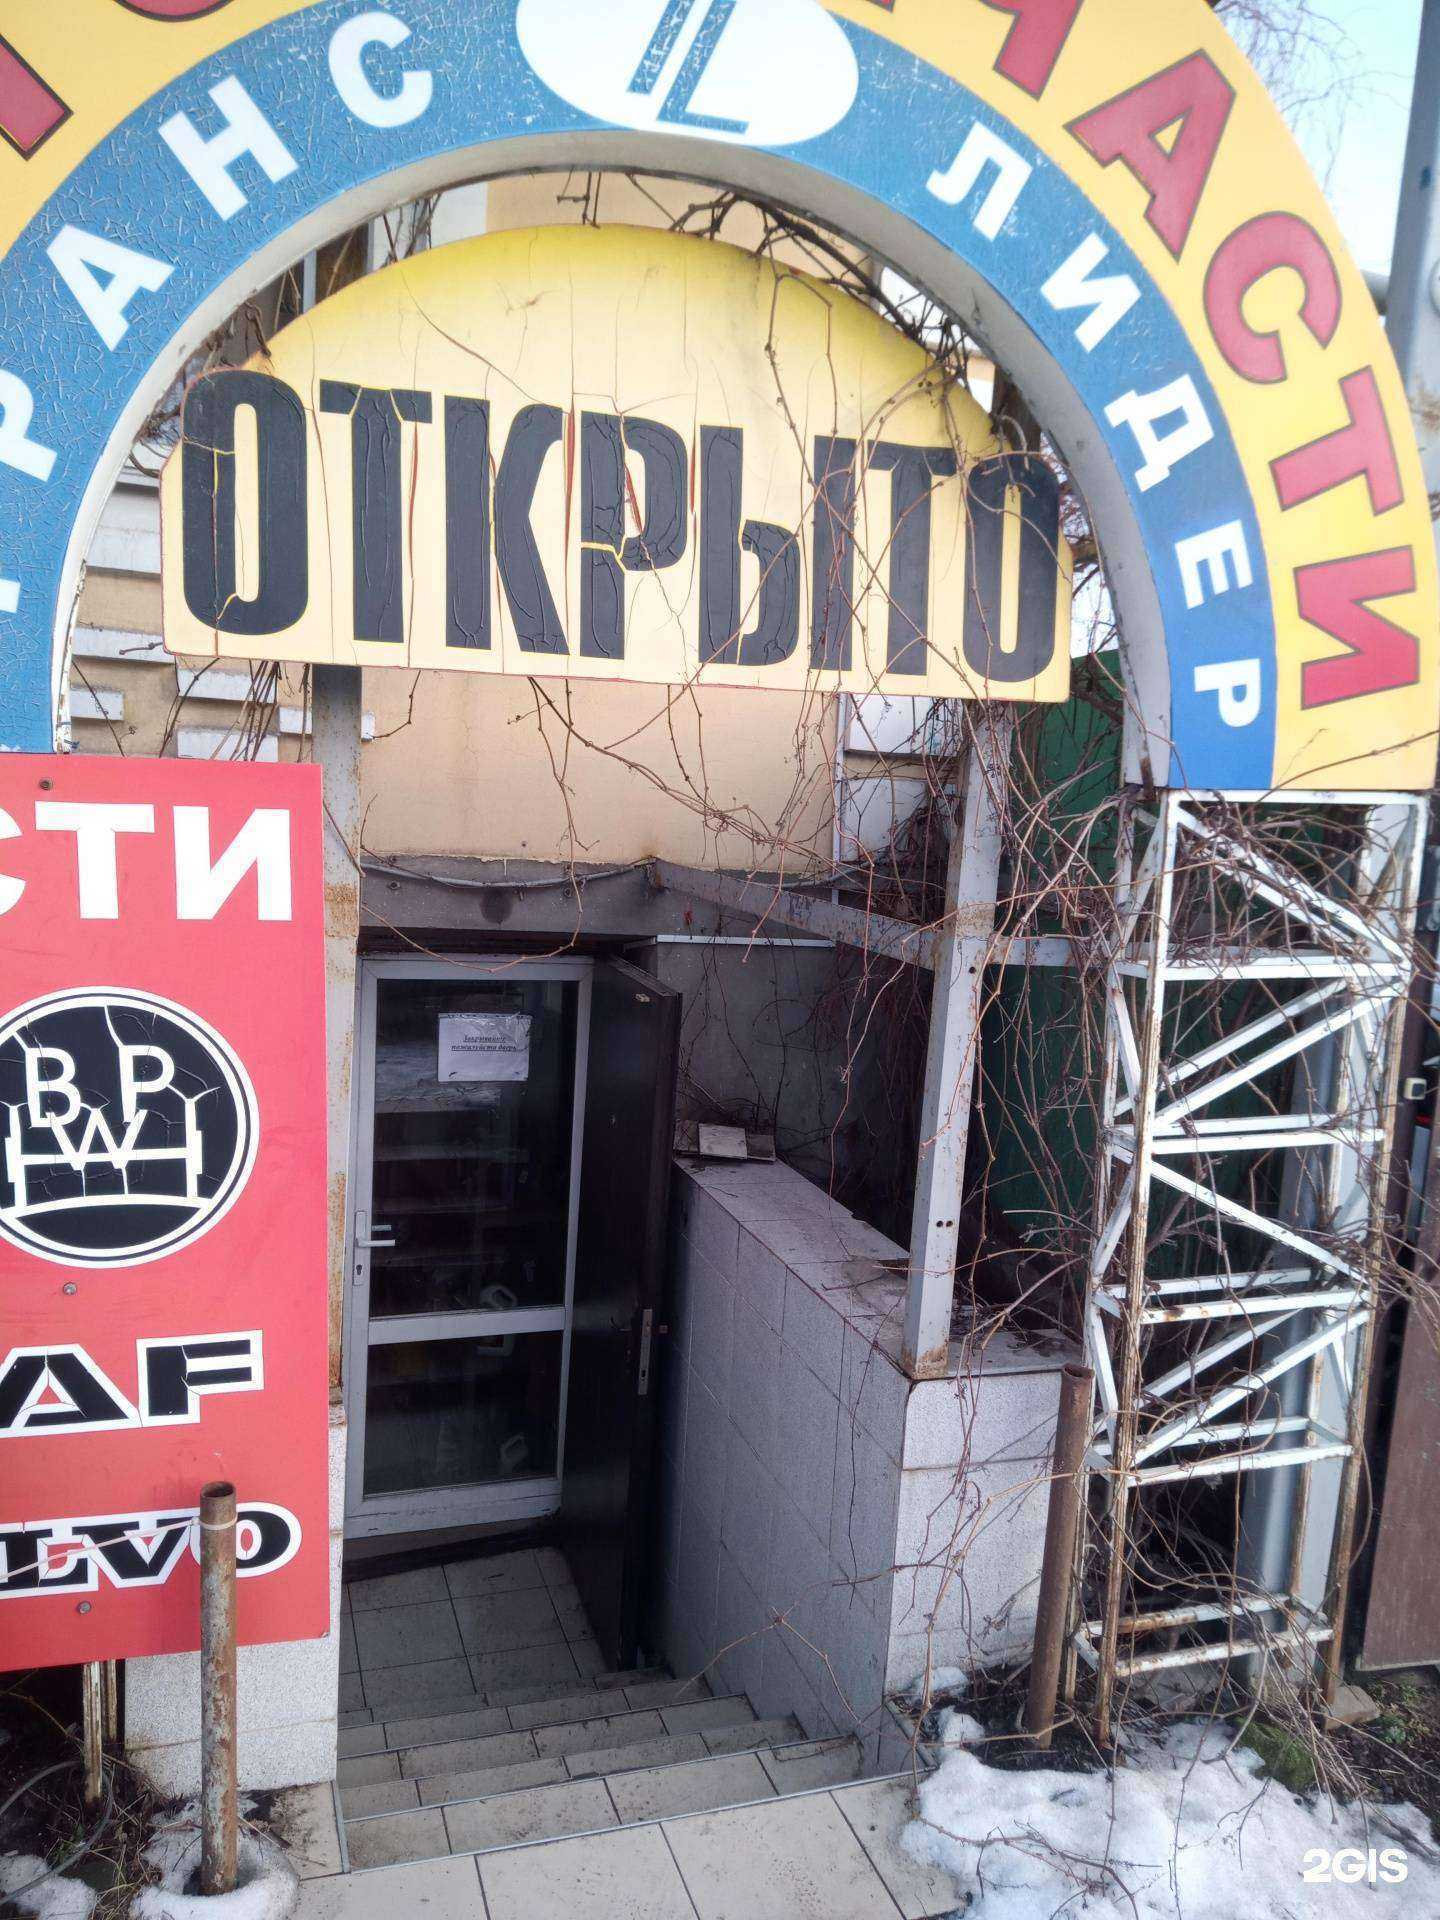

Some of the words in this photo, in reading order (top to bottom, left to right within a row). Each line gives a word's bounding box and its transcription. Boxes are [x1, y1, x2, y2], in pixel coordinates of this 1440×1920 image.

[0, 13, 433, 613] РАНС
[926, 121, 1262, 728] ЛИДЕР
[182, 368, 1058, 685] ОТКРЫТО
[0, 800, 293, 922] ТИ
